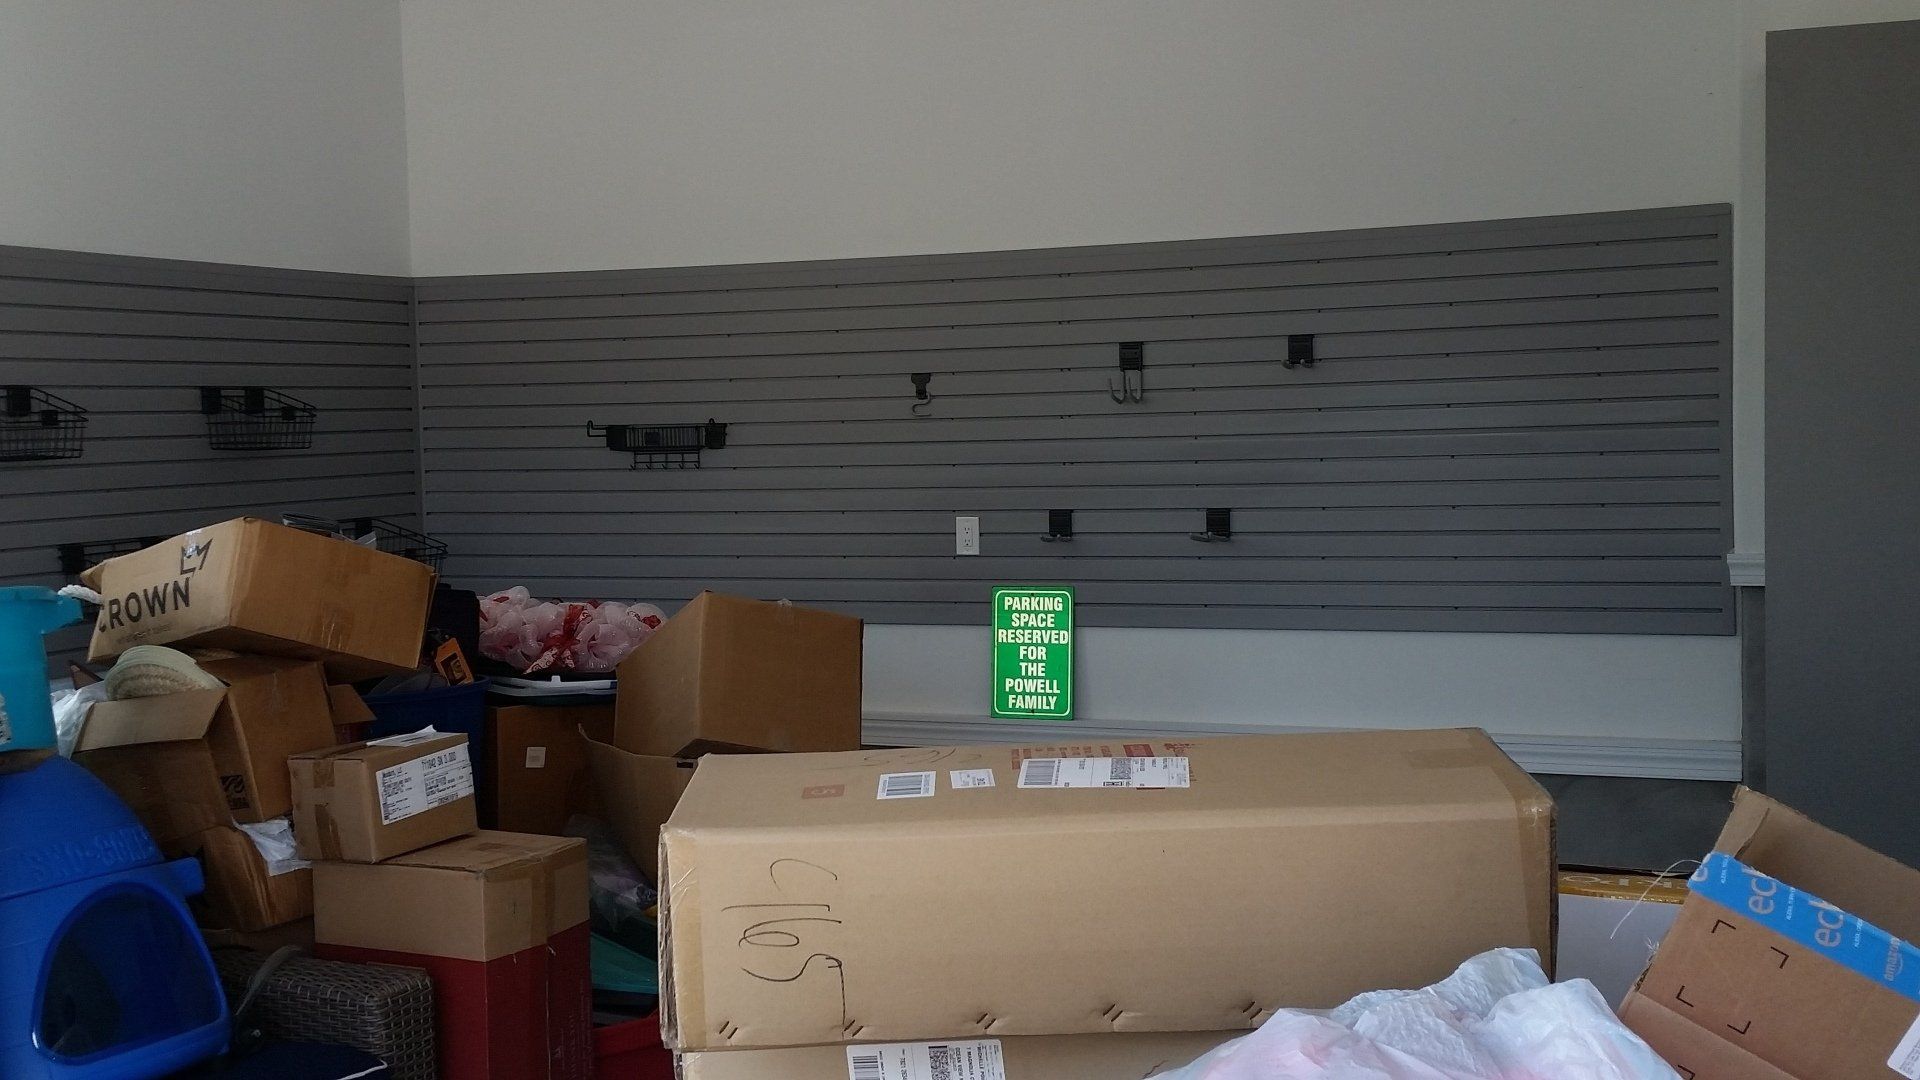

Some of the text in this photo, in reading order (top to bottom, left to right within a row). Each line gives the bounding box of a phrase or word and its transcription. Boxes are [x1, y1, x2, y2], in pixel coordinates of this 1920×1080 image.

[1004, 597, 1063, 611] PARKING
[1011, 613, 1055, 627] SPACE
[998, 629, 1069, 644] RESERVED
[1019, 646, 1047, 660] FOR
[1019, 662, 1046, 676] THE
[1005, 678, 1061, 693] POWELL
[1008, 695, 1057, 710] FAMILY
